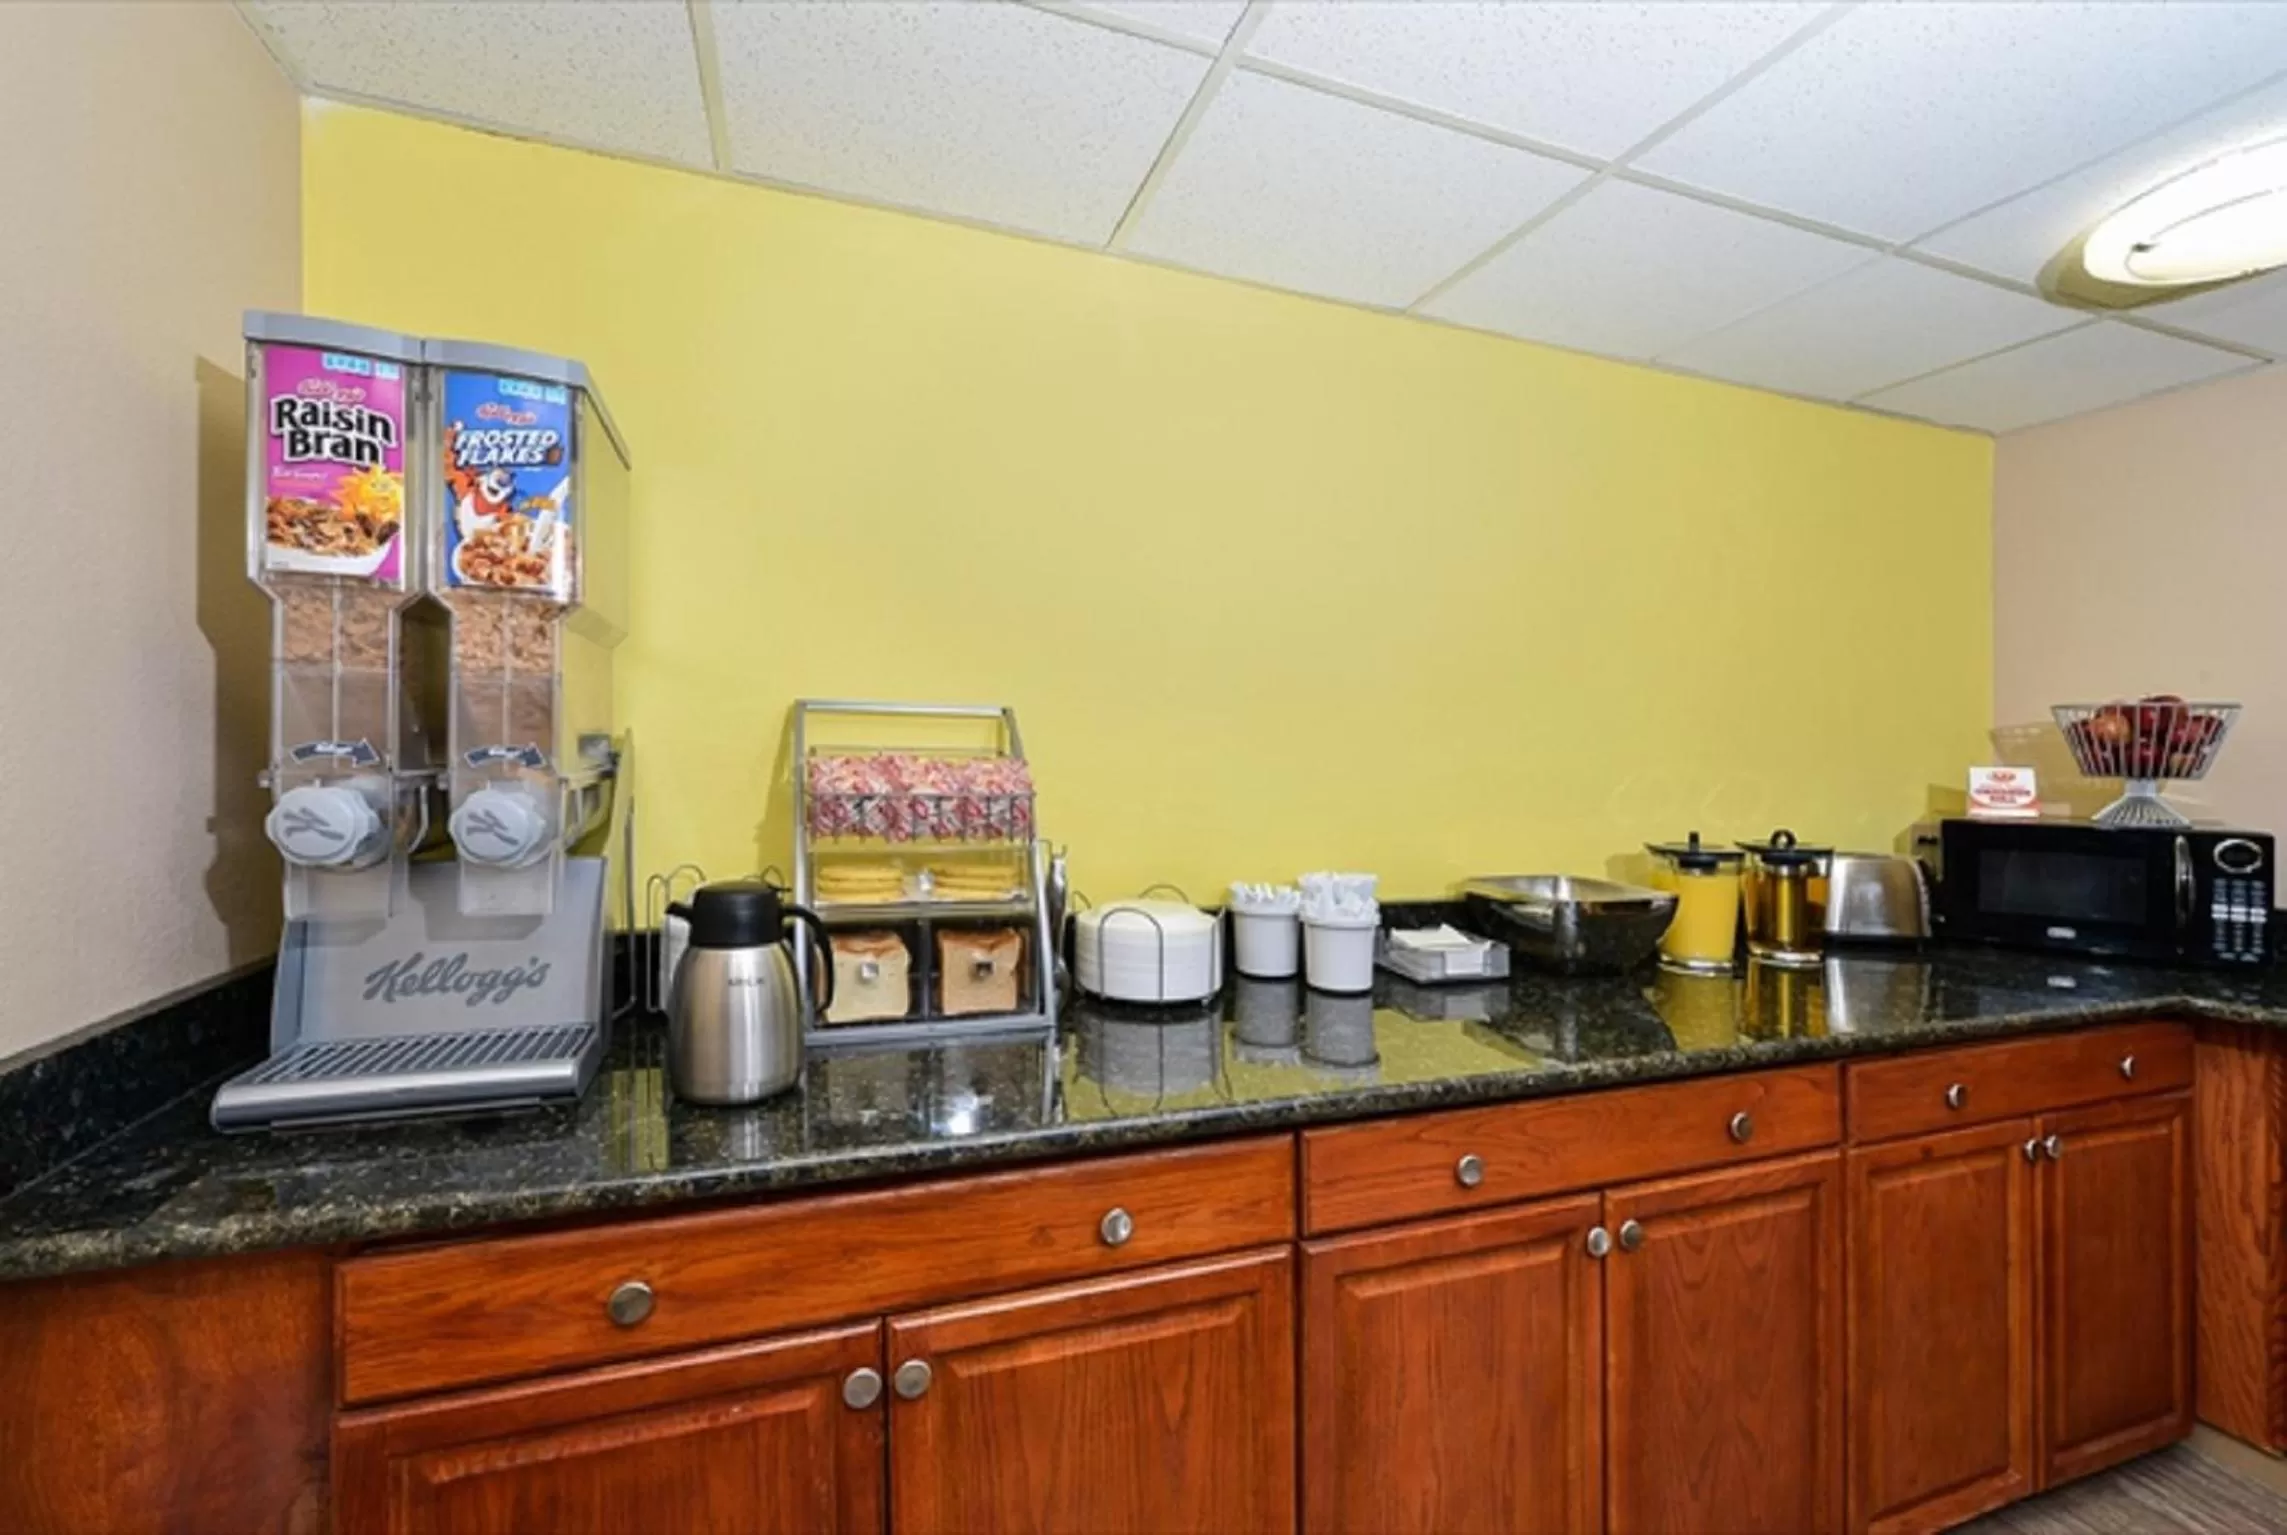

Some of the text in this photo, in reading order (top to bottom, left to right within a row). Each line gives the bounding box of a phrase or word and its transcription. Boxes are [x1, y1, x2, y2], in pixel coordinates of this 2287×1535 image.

[272, 396, 395, 446] Raisin
[285, 429, 383, 467] Bran
[455, 429, 559, 453] FROSTED
[456, 447, 544, 467] FLAKES
[362, 951, 552, 1007] Kellogg's
